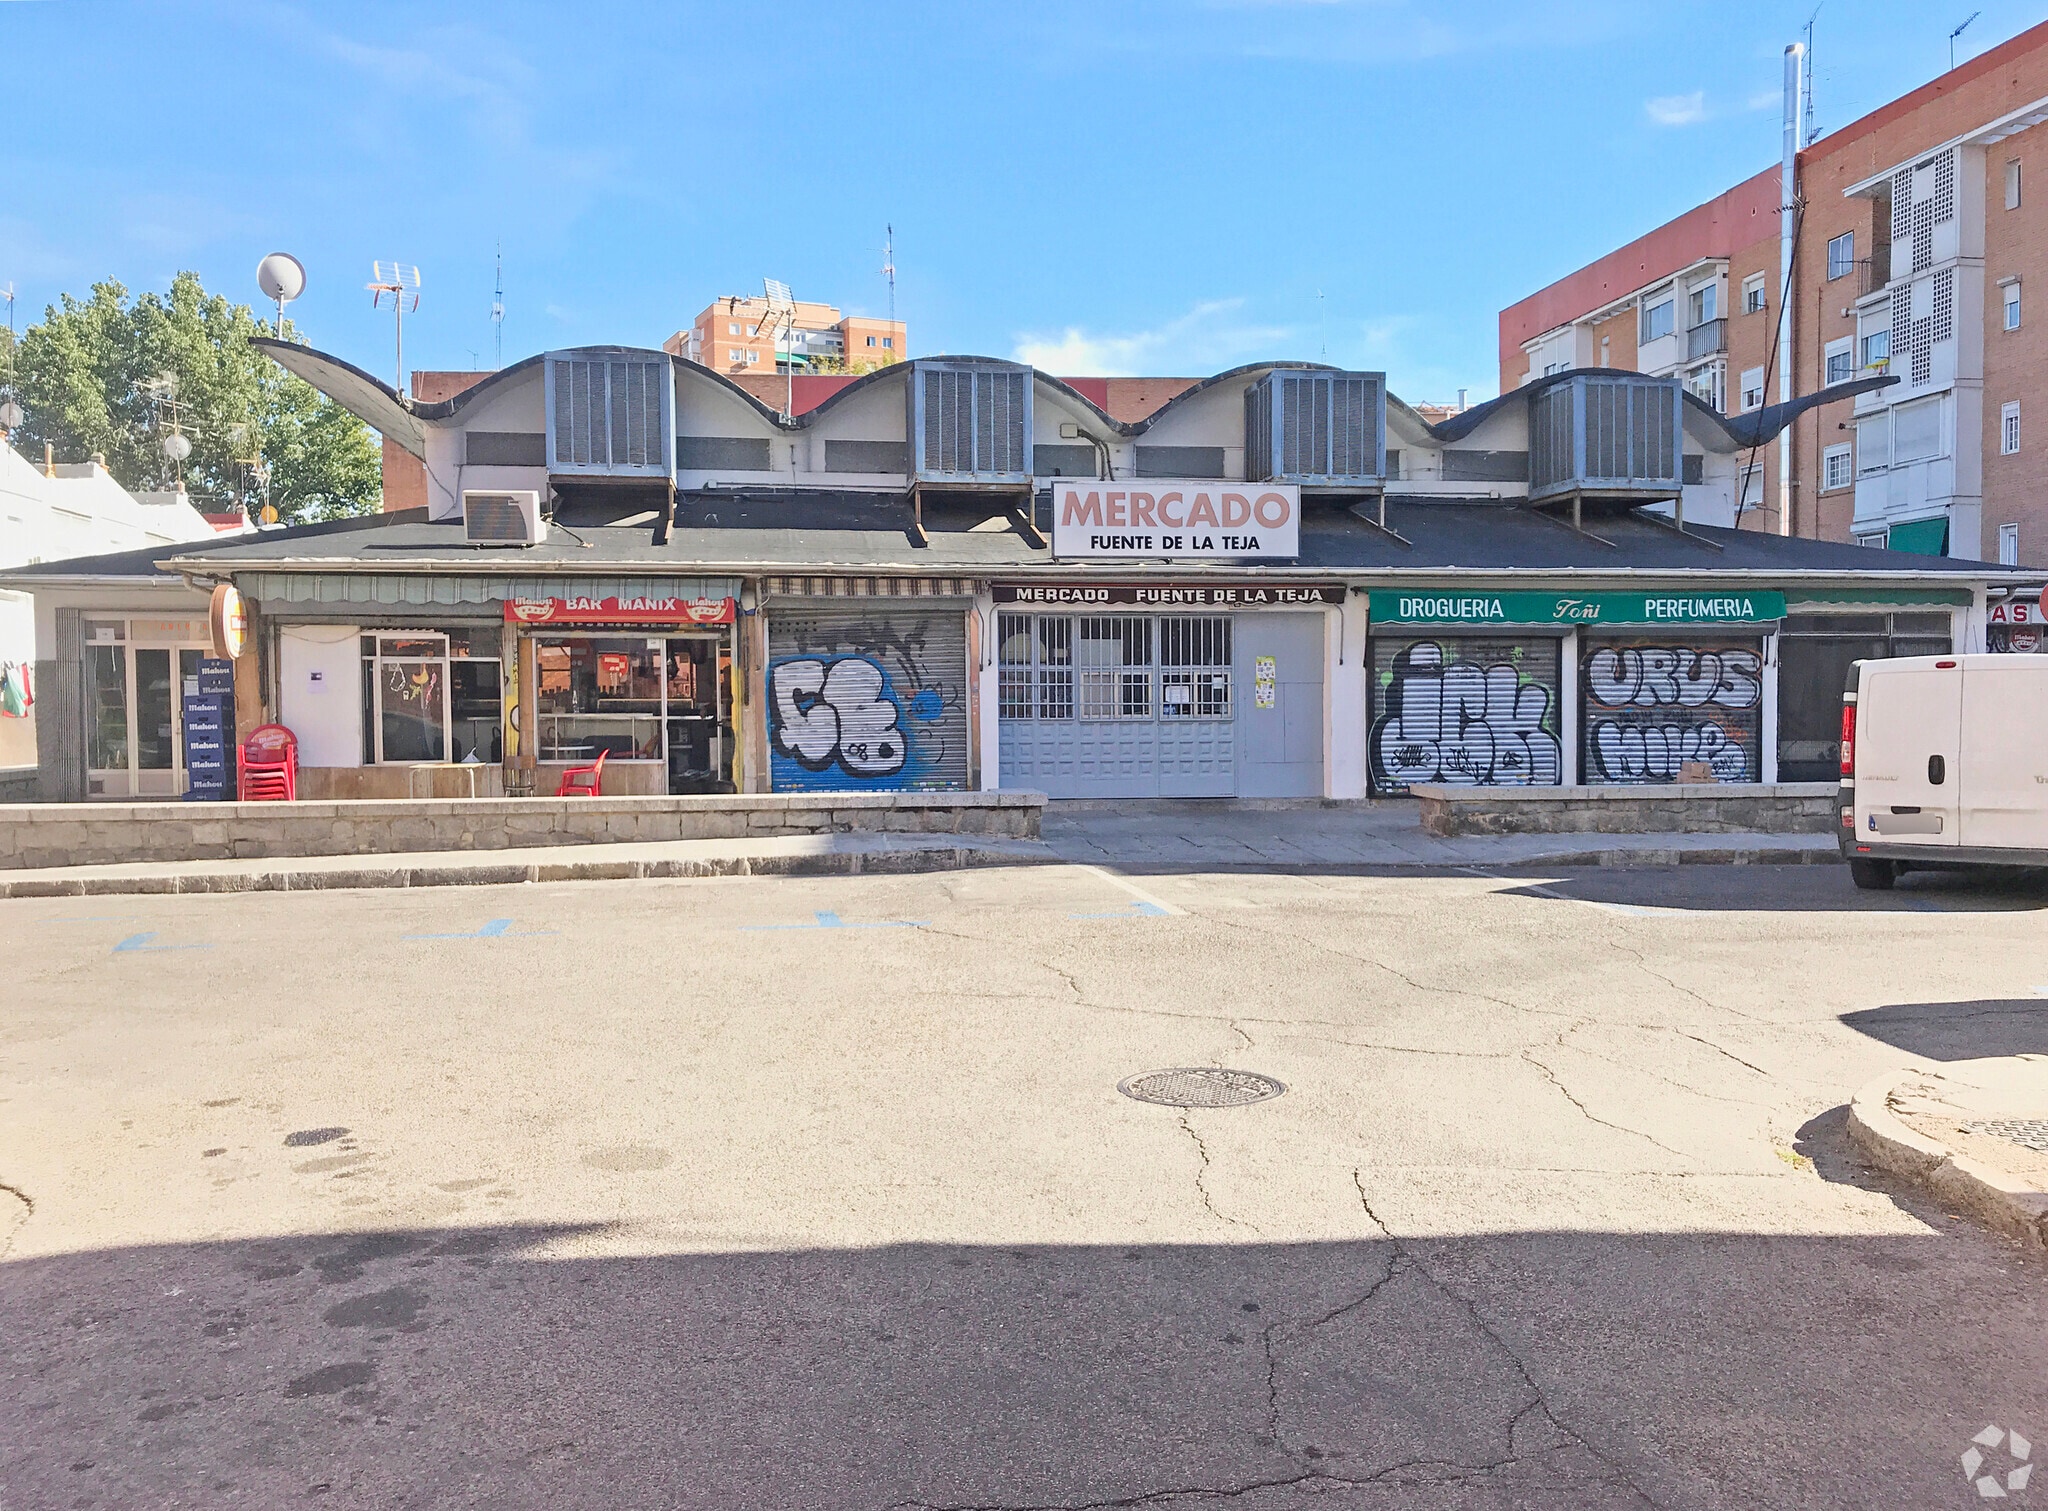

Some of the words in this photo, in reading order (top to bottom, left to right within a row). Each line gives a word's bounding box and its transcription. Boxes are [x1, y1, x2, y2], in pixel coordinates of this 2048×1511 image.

[1061, 491, 1291, 529] MERCADO
[1091, 535, 1153, 550] FUENTE
[1162, 536, 1183, 550] DE
[1192, 536, 1214, 550] LA
[1222, 536, 1260, 550] TEJA
[1016, 588, 1110, 601] MERCADO
[1136, 589, 1206, 602] FUENTE
[1213, 589, 1236, 602] DE
[1244, 589, 1268, 602] LA
[1275, 588, 1324, 601] TEJA
[565, 597, 603, 611] BAR
[617, 598, 676, 611] MANIX
[688, 597, 725, 607] Mahou
[1399, 598, 1505, 618] DROGUERIA
[1552, 599, 1601, 619] Toñi
[1645, 598, 1754, 618] PERFUMERIA
[201, 667, 230, 675] Mahou
[202, 686, 231, 694] Mahou
[188, 704, 217, 712] Mahou
[189, 723, 218, 731] Mahou
[190, 742, 219, 750] Mahou
[191, 761, 220, 769] Mahou
[193, 780, 223, 788] Mahou
